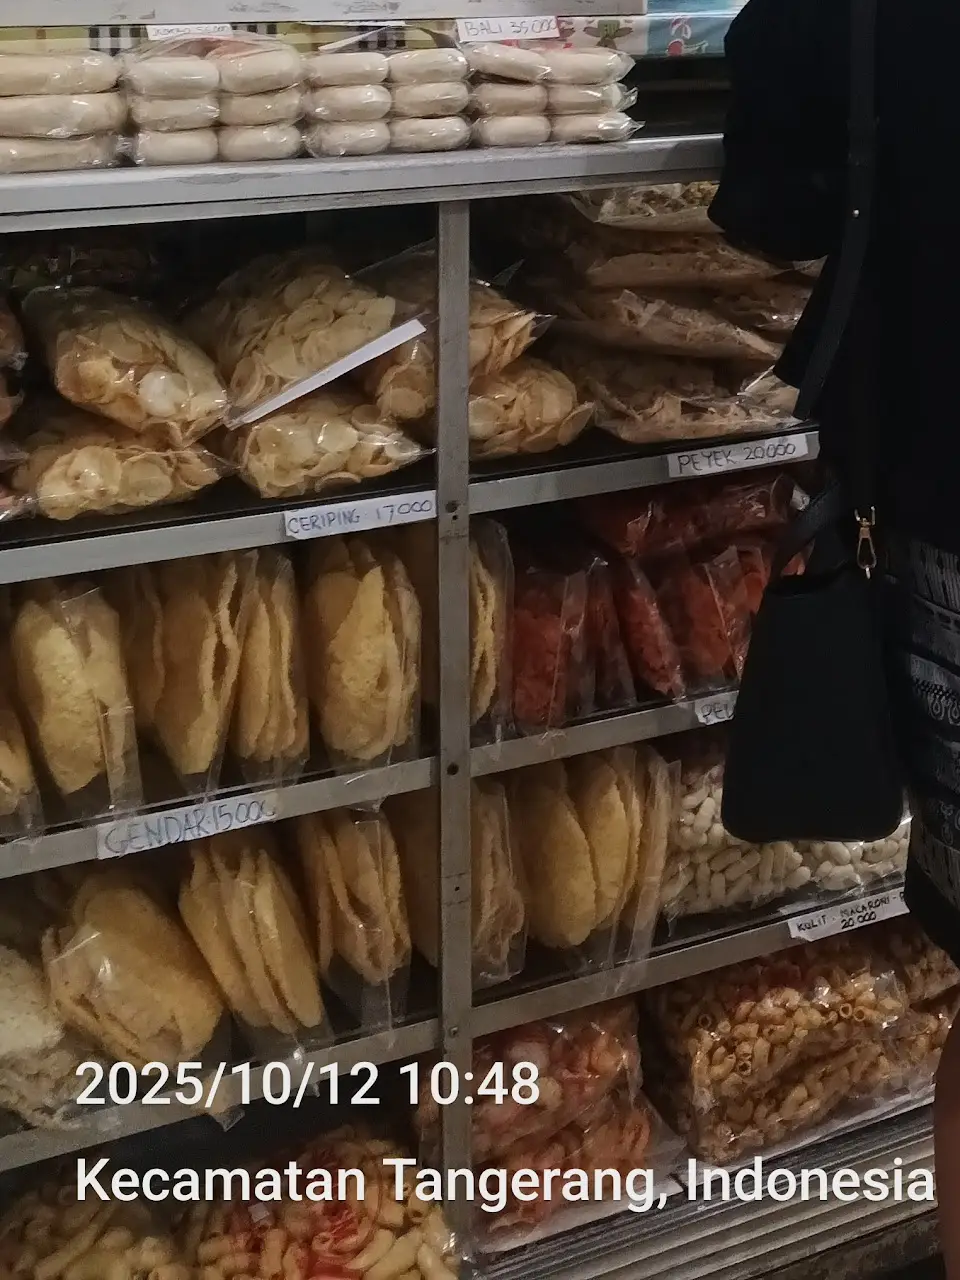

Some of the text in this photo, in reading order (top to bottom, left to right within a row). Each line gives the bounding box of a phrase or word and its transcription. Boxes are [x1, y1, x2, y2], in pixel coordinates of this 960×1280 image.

[464, 20, 503, 37] BALI
[677, 450, 737, 474] PEYEK
[288, 508, 361, 534] CERIPING
[796, 914, 827, 932] KULIT
